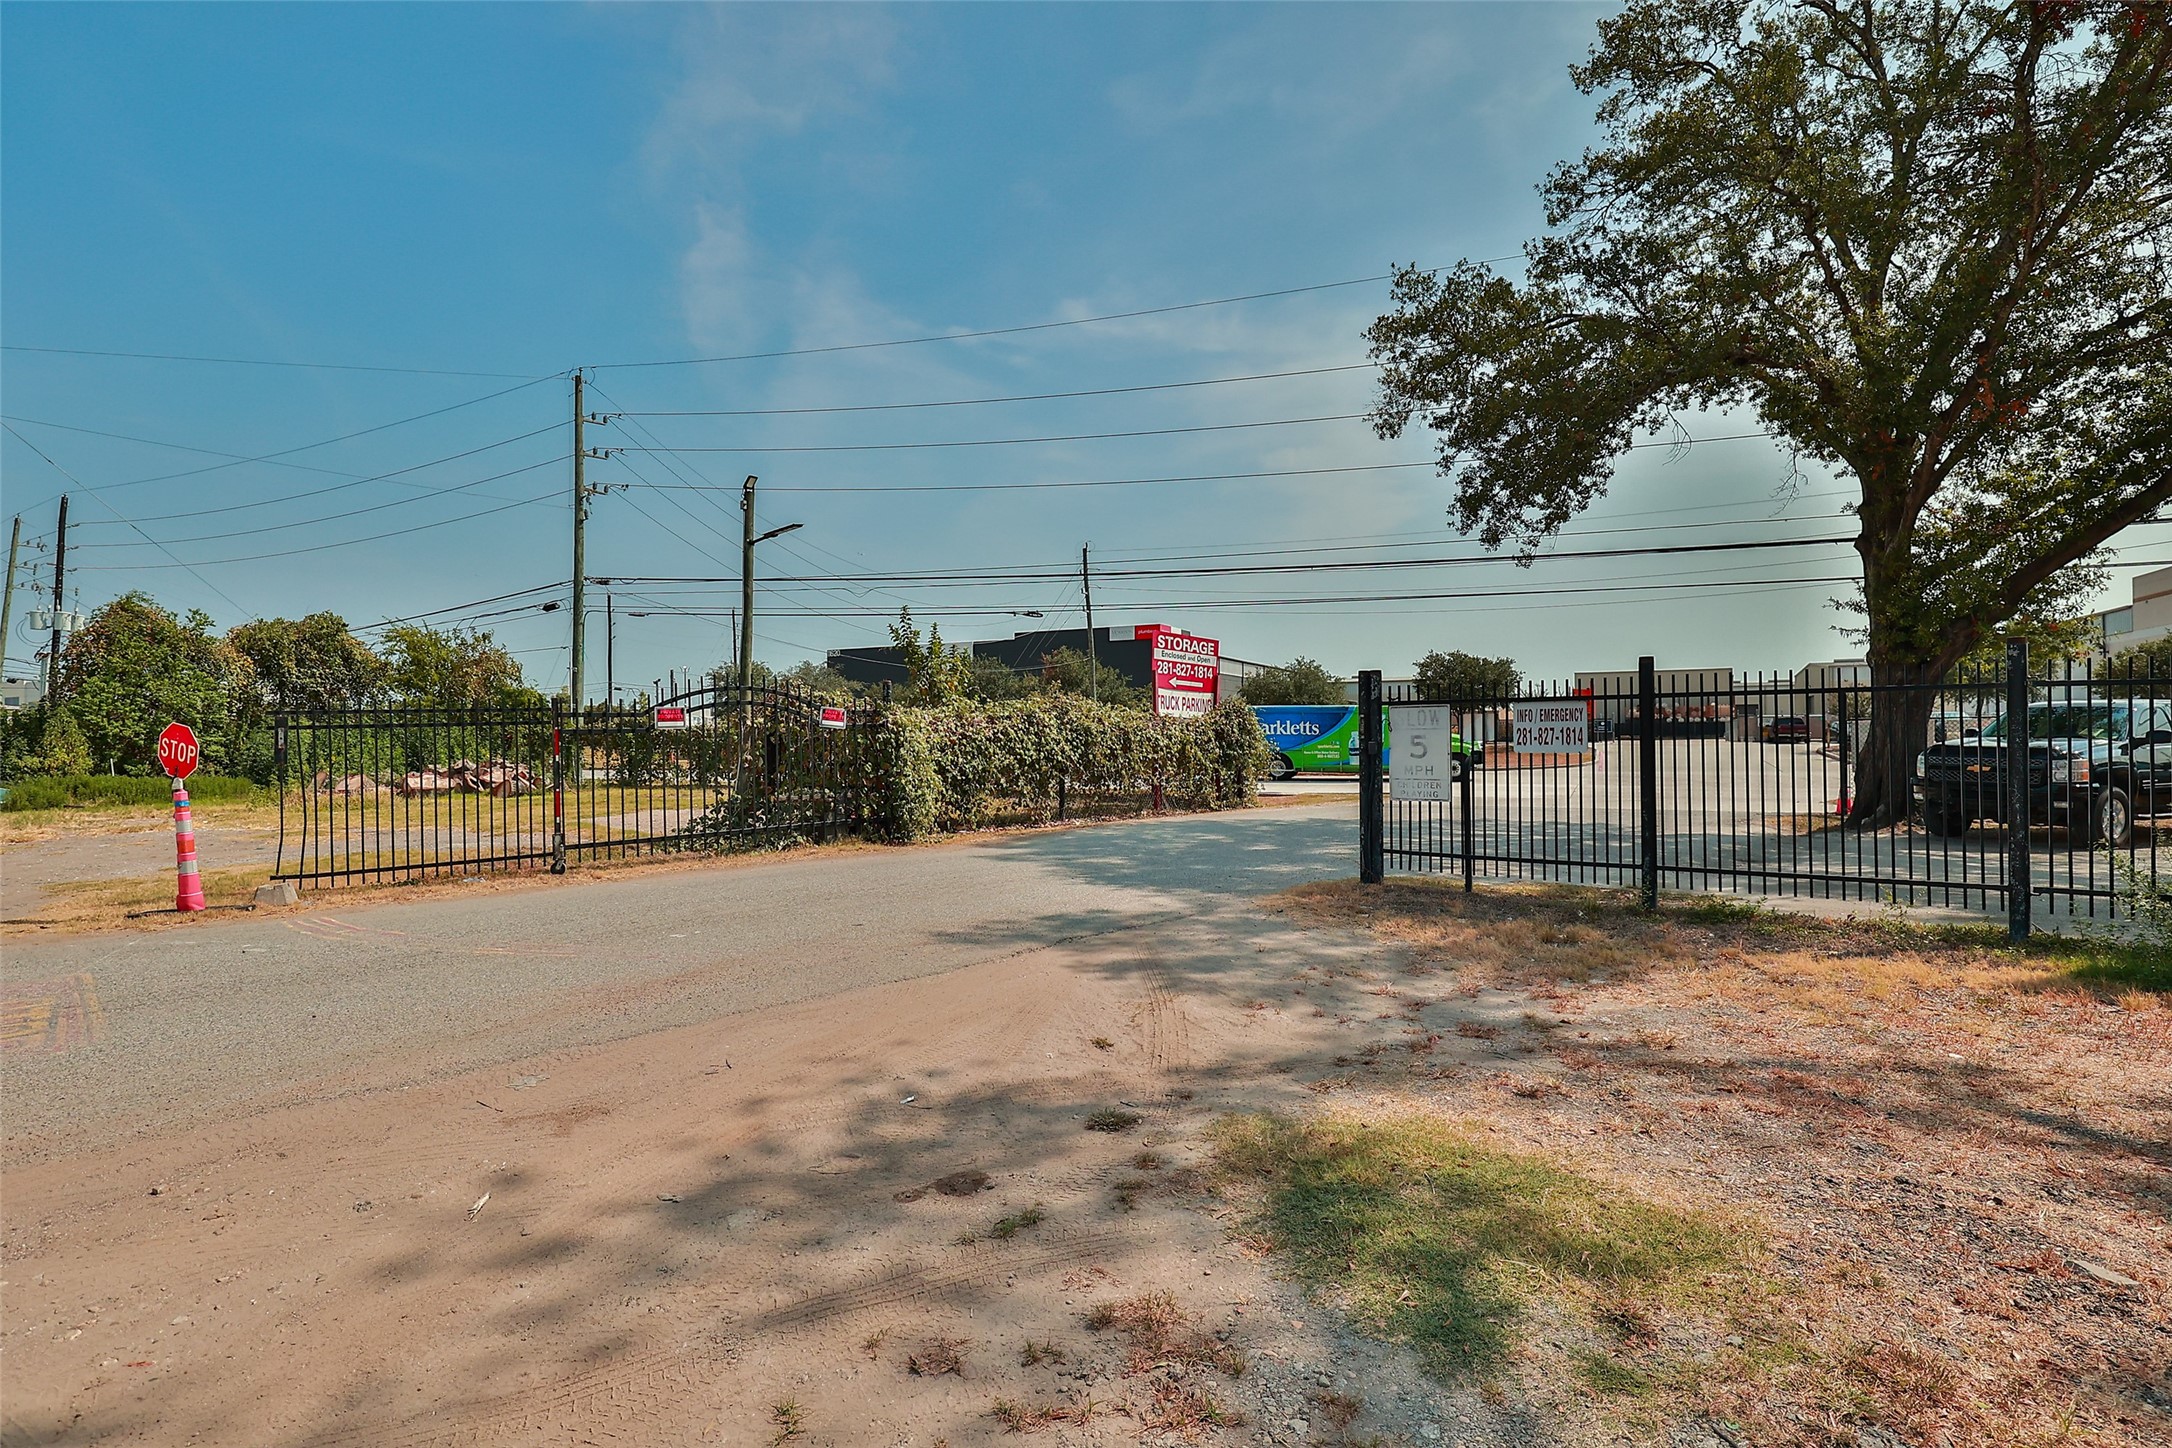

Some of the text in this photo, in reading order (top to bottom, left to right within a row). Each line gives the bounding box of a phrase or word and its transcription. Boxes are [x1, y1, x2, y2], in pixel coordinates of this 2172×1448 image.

[1157, 635, 1215, 655] STORAGE
[1161, 650, 1187, 661] Enclosed
[1196, 655, 1211, 664] Open
[1157, 661, 1213, 679] 281-827-1814
[1181, 696, 1213, 713] PARKING
[1516, 709, 1533, 723] INFO
[1539, 707, 1584, 722] EMERGENCY
[1259, 720, 1320, 735] arkletts
[1516, 726, 1584, 746] 281-827-1814
[160, 737, 197, 764] STOP
[1410, 735, 1428, 759] 5
[1404, 765, 1434, 776] MPH
[1397, 781, 1442, 790] CHILDREN
[1400, 789, 1439, 798] PLAYING
